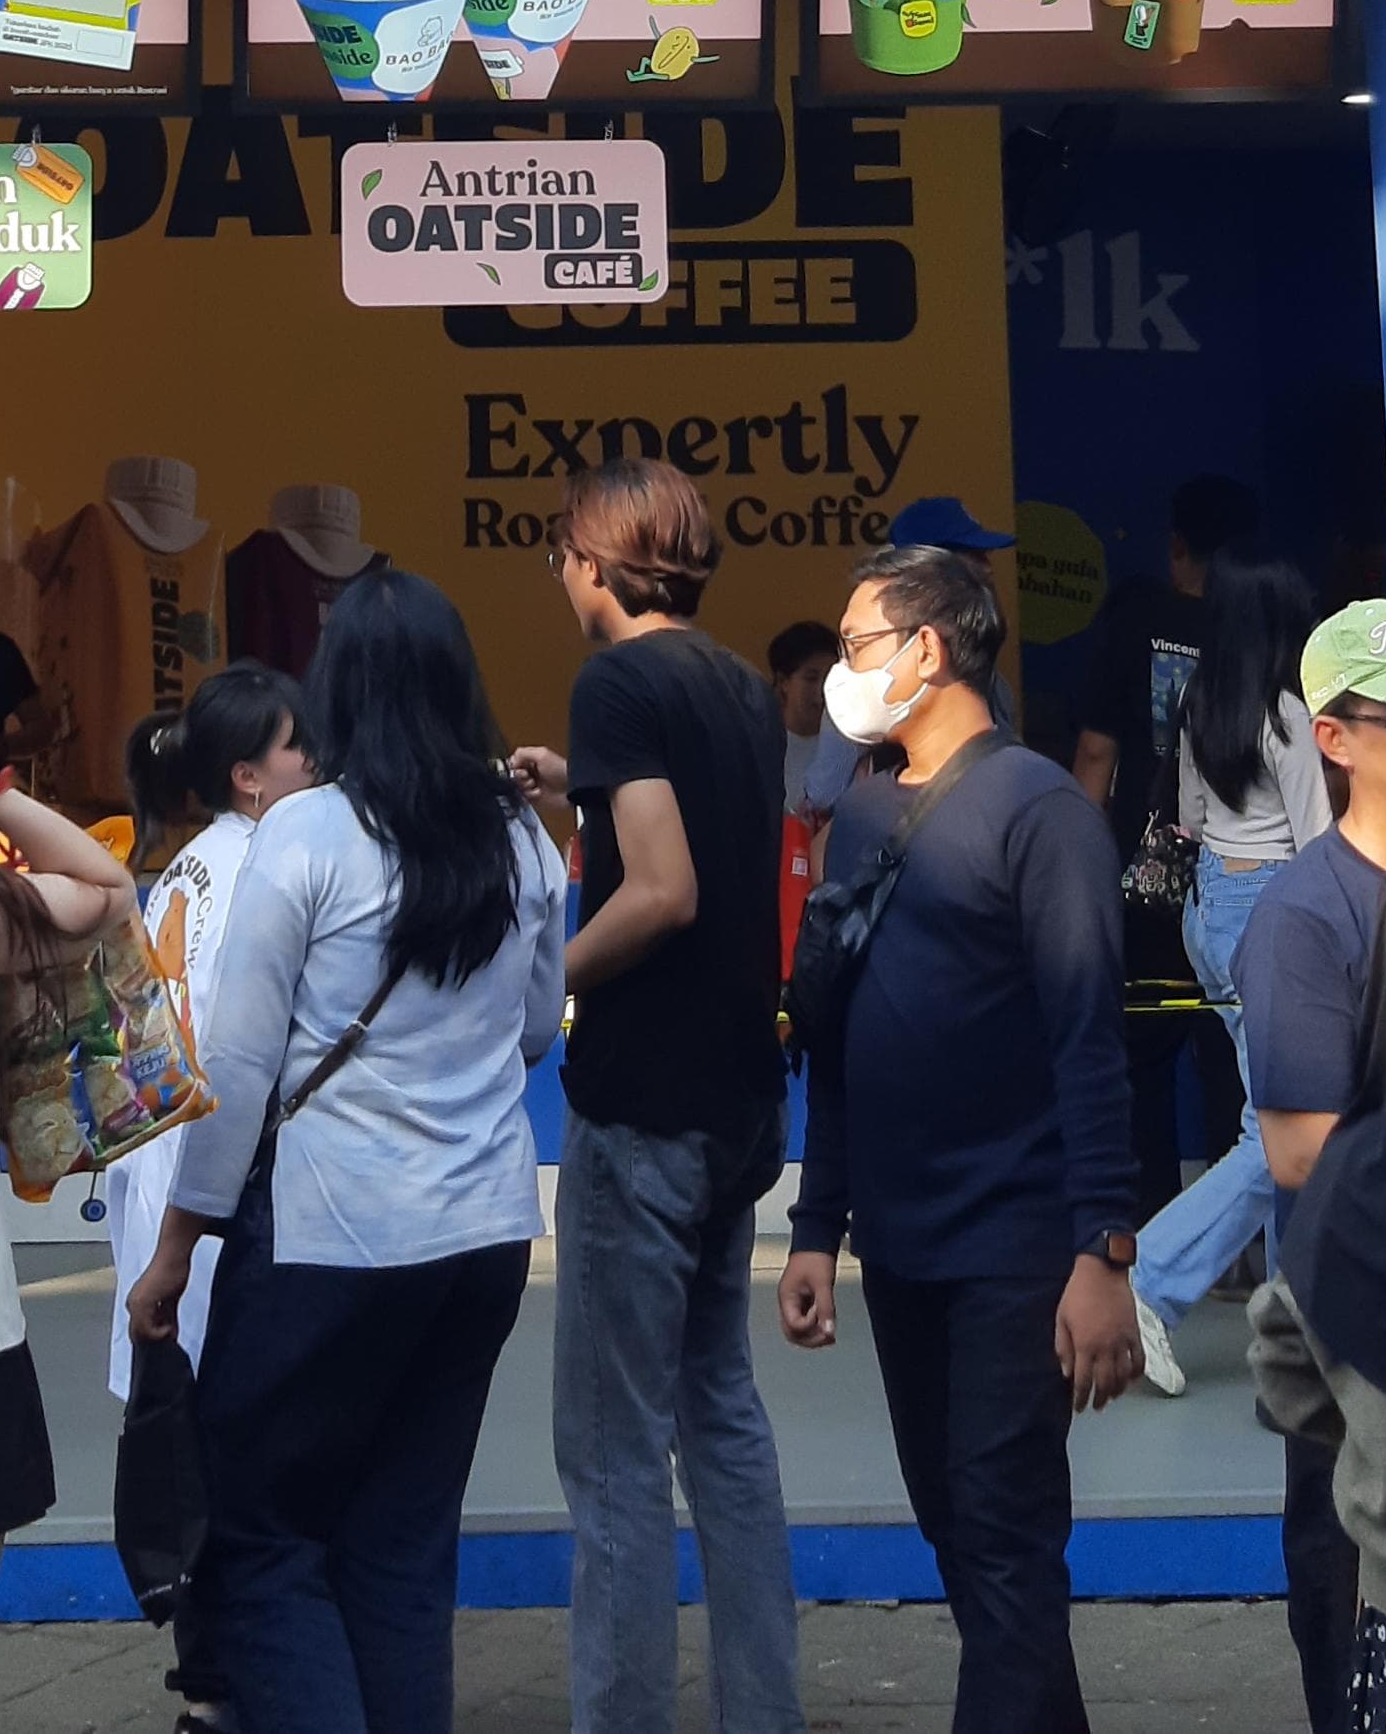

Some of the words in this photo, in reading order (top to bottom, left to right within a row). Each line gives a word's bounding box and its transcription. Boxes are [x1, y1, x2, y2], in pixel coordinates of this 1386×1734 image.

[420, 159, 598, 197] Antrian
[368, 203, 641, 253] OATSIDE
[554, 255, 634, 285] CAFÉ
[464, 383, 920, 498] Expertly
[725, 496, 891, 548] Coffe
